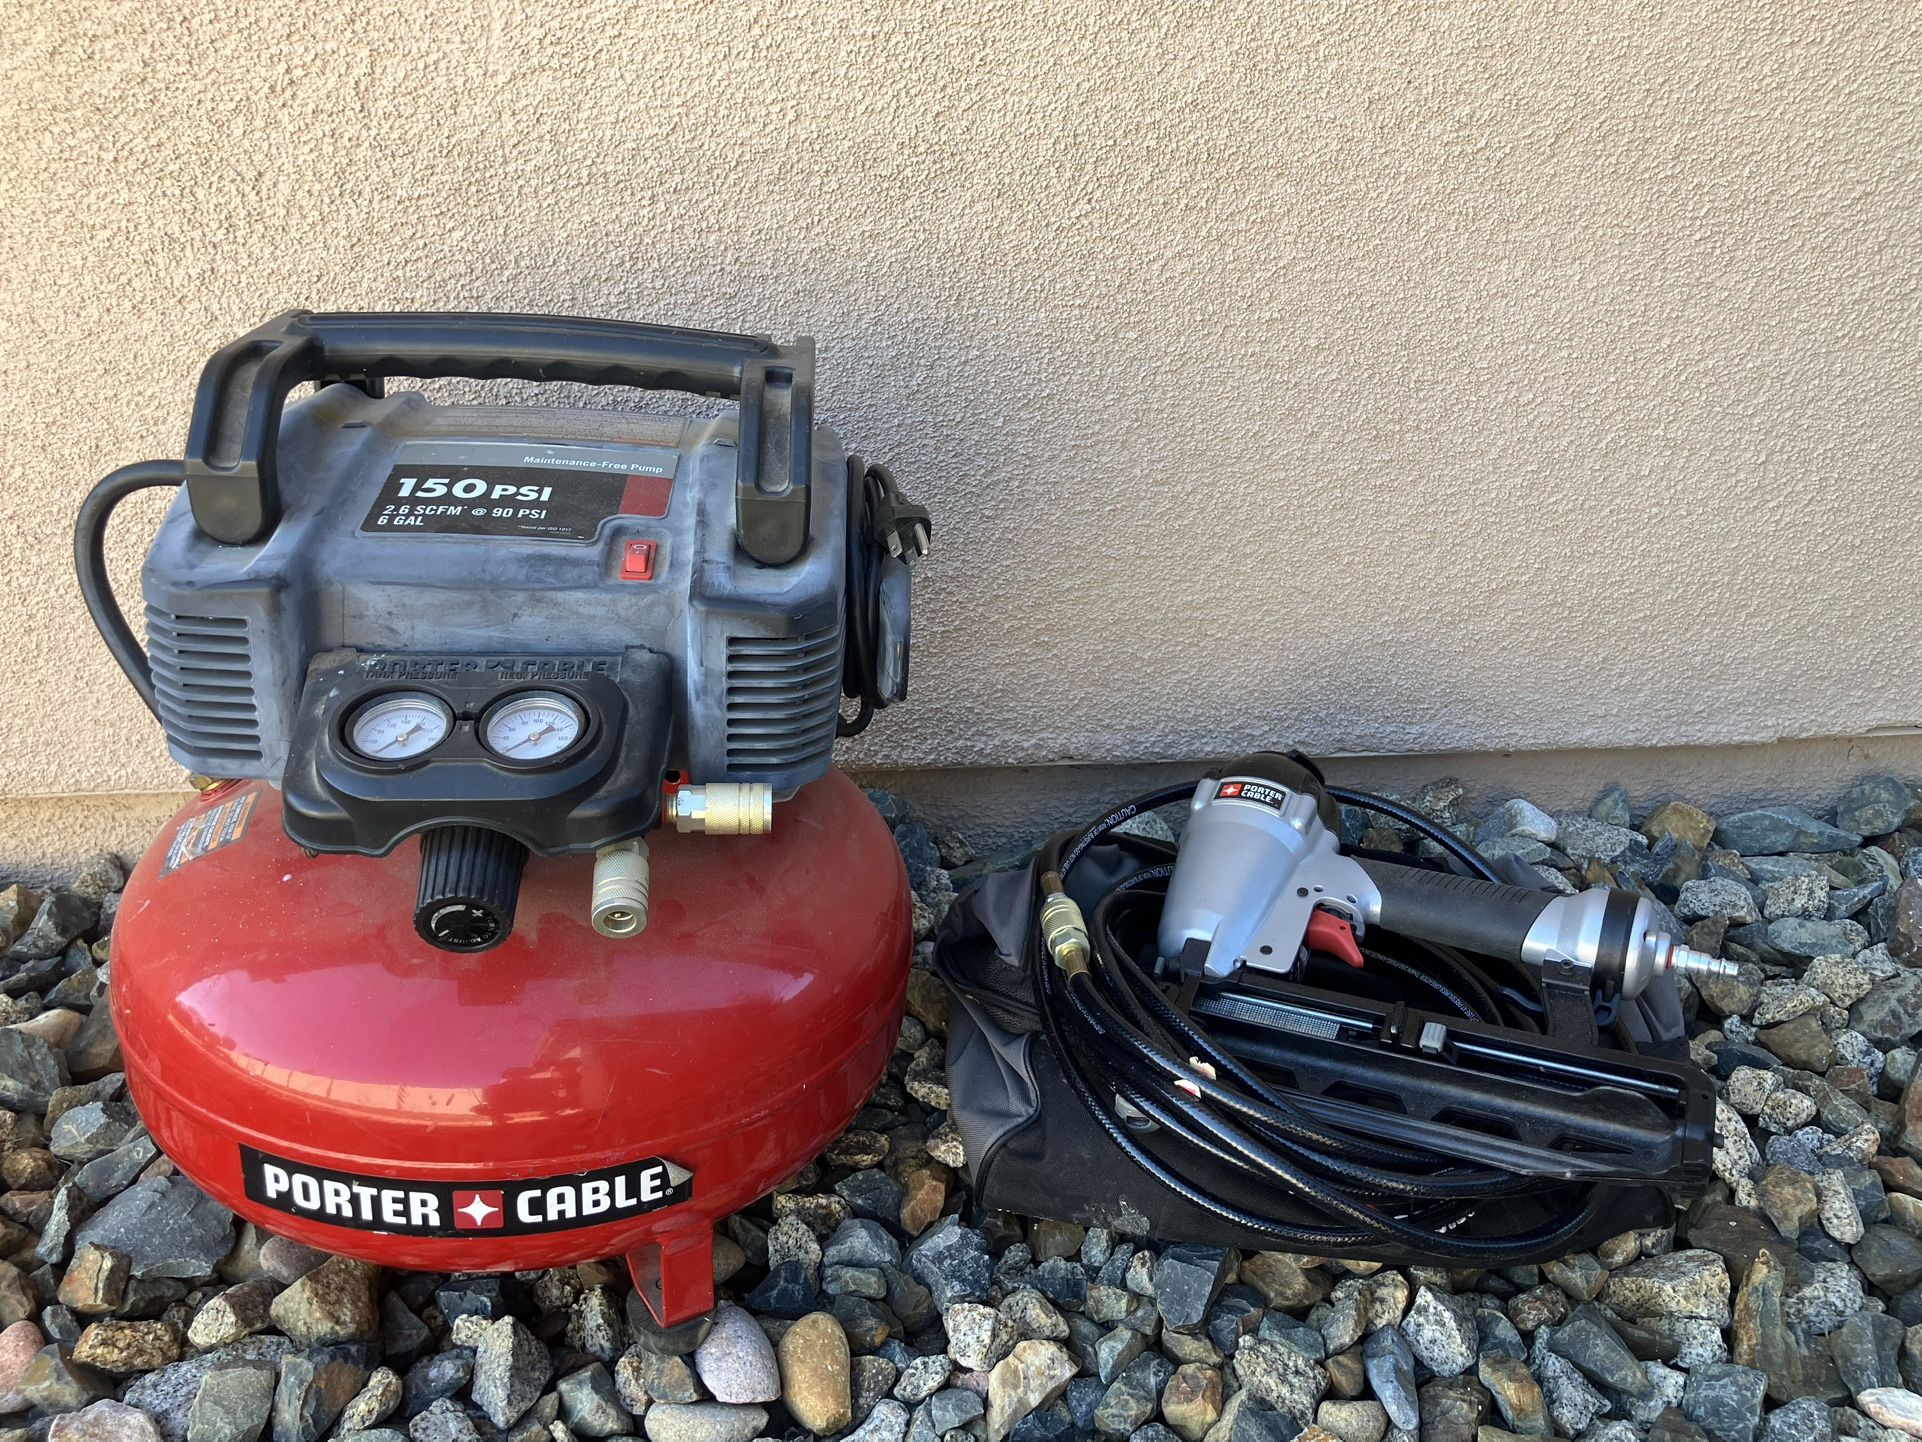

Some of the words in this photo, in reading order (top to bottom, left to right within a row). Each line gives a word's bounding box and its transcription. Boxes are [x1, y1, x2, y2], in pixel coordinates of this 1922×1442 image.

[523, 456, 627, 470] Maintenance-Free
[631, 463, 663, 474] Pump
[397, 478, 488, 499] 150
[490, 484, 553, 501] PSI
[382, 505, 410, 515] 2.6
[471, 507, 487, 516] @
[491, 507, 513, 518] 90
[517, 508, 547, 519] PSI
[377, 515, 388, 525] 6
[393, 515, 424, 526] GAL
[397, 671, 458, 680] PRESSURE
[529, 671, 588, 680] PRESSURE
[1243, 784, 1283, 801] PORTER
[263, 1162, 441, 1227] PORTER
